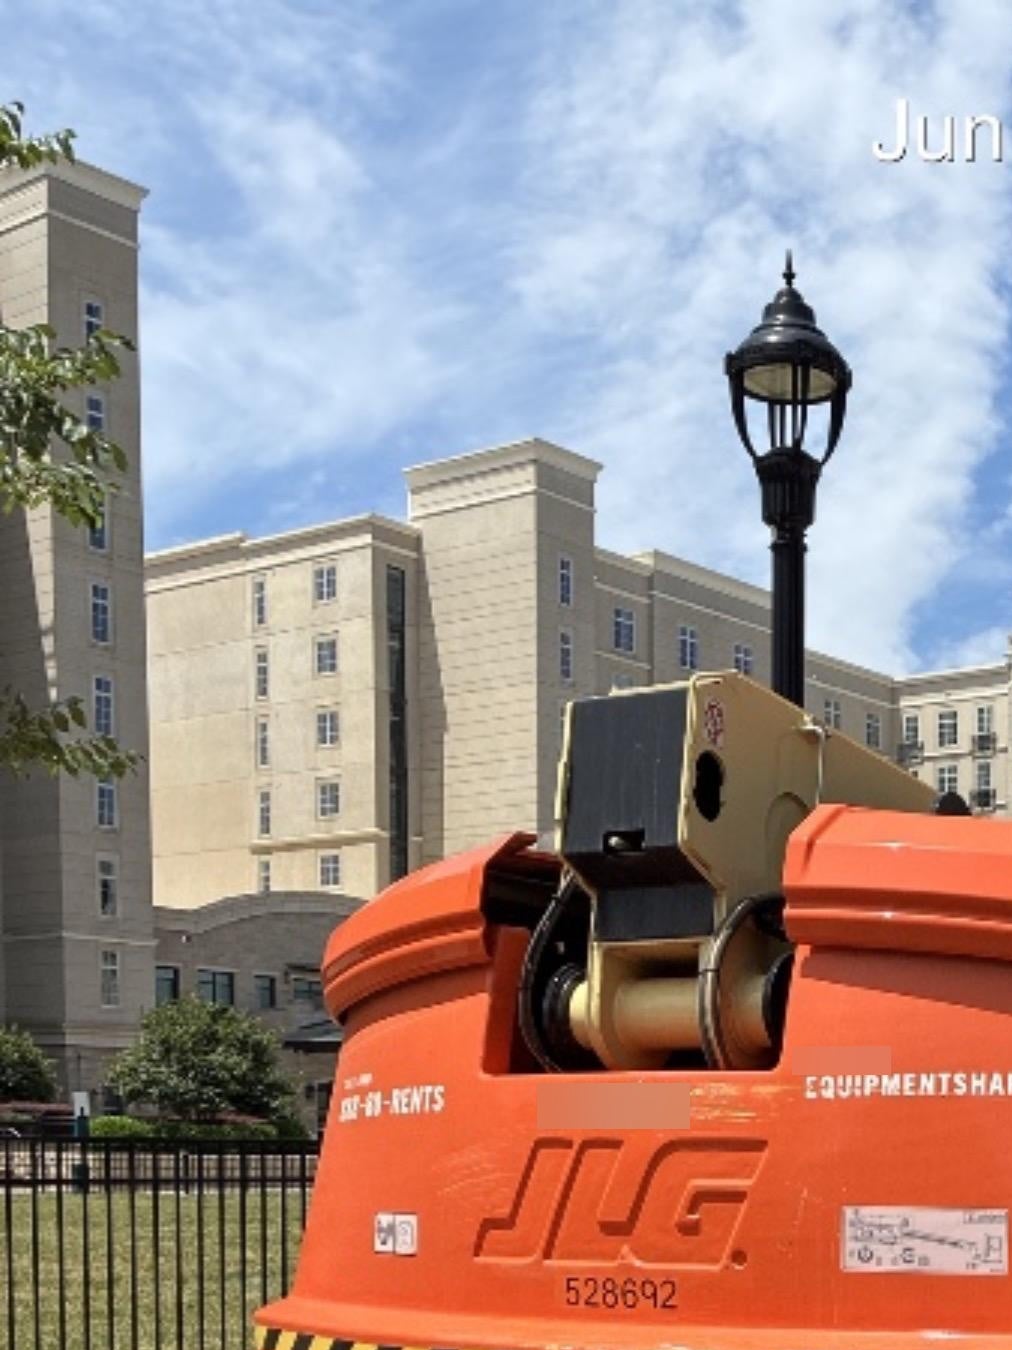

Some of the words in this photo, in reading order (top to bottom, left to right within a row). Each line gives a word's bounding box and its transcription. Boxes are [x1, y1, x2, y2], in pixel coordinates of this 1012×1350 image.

[338, 1085, 446, 1122] --RENTS
[473, 1136, 769, 1272] JLG
[565, 1277, 679, 1310] 528692
